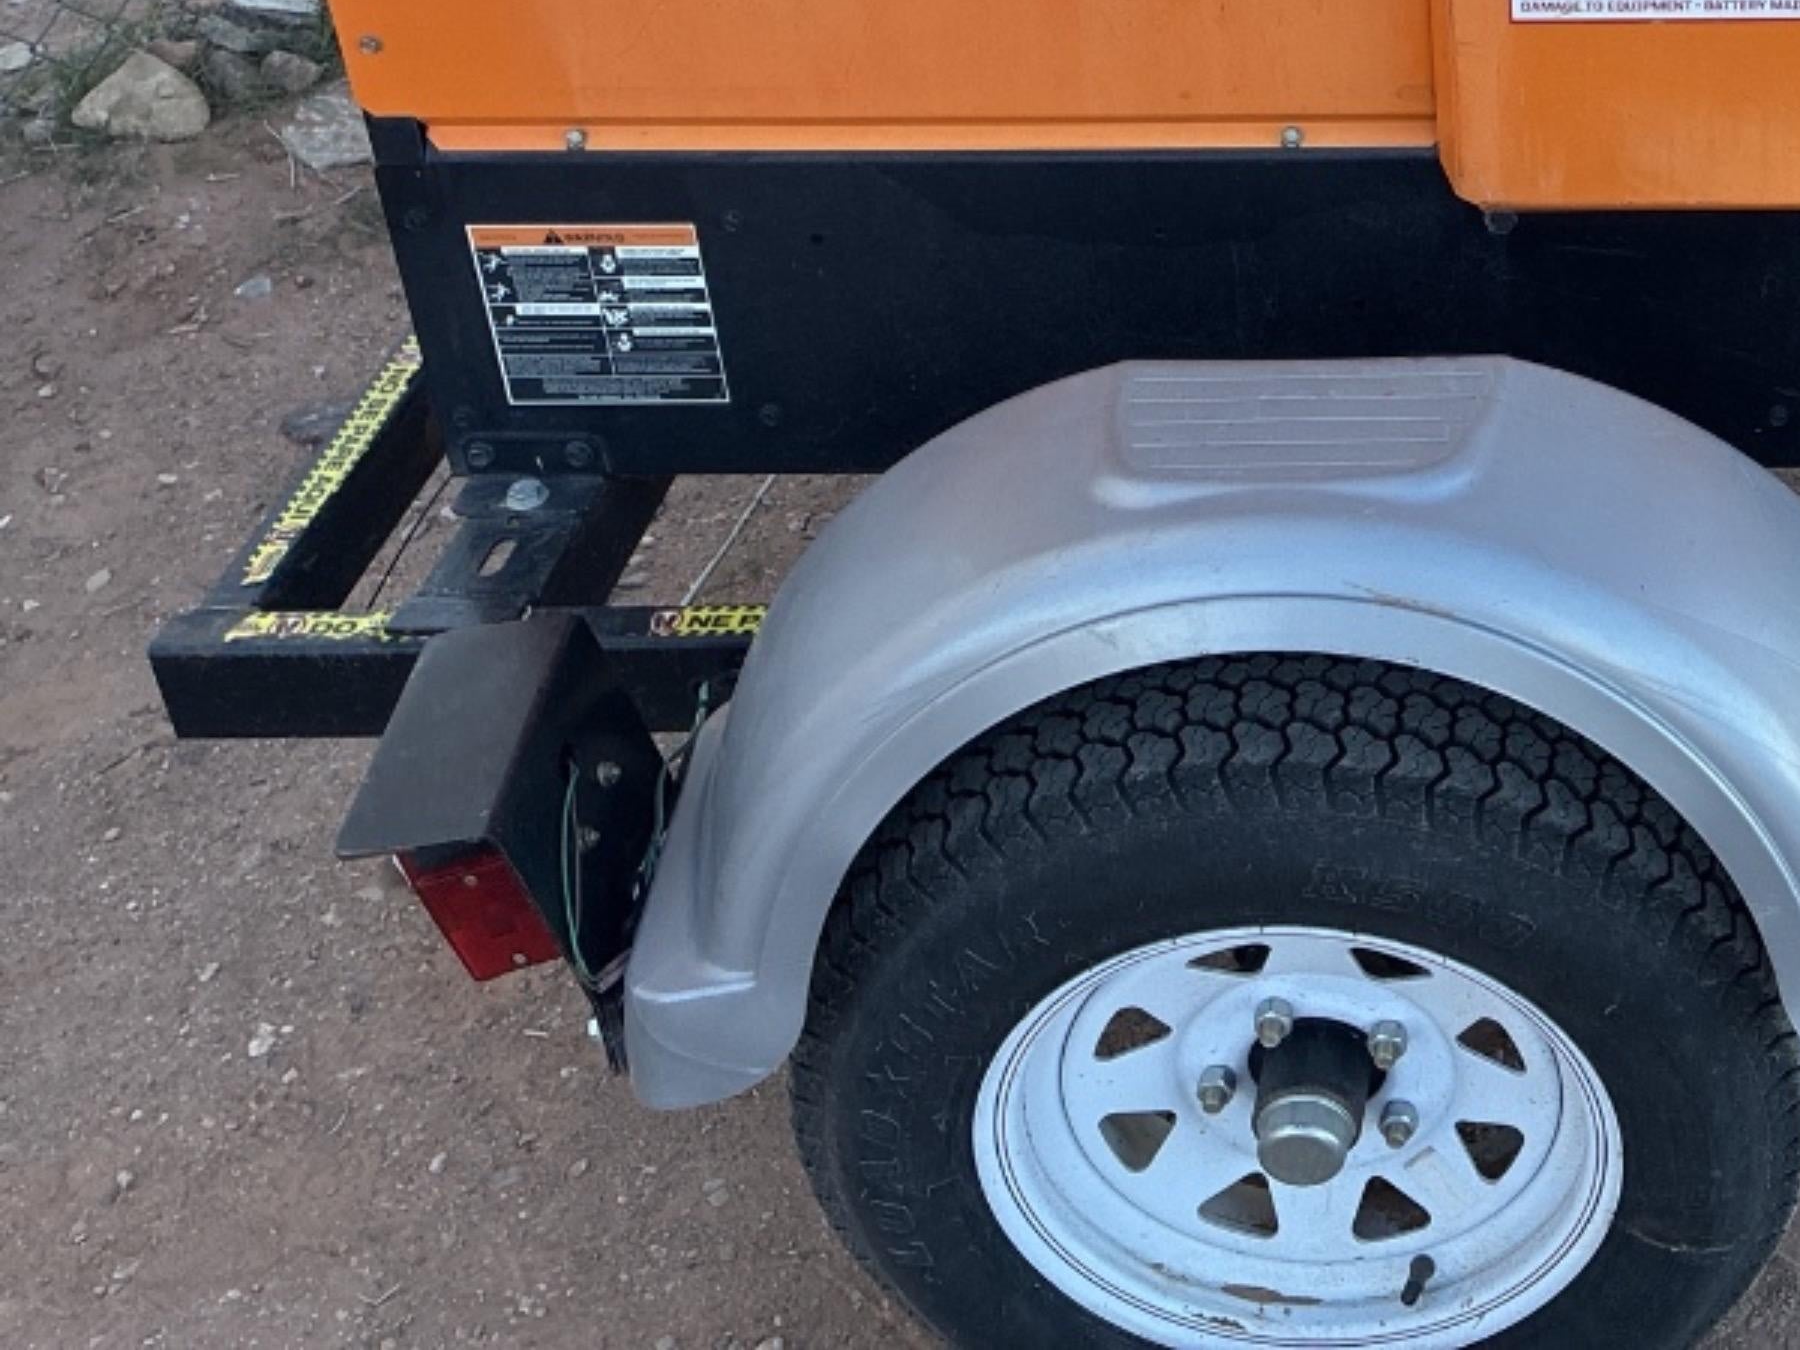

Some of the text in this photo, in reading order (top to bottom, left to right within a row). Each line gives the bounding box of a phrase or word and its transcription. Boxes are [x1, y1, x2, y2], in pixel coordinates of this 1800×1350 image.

[1585, 0, 1603, 12] TO
[1607, 0, 1692, 12] EQUIPMENT
[1703, 0, 1766, 11] BATTERY
